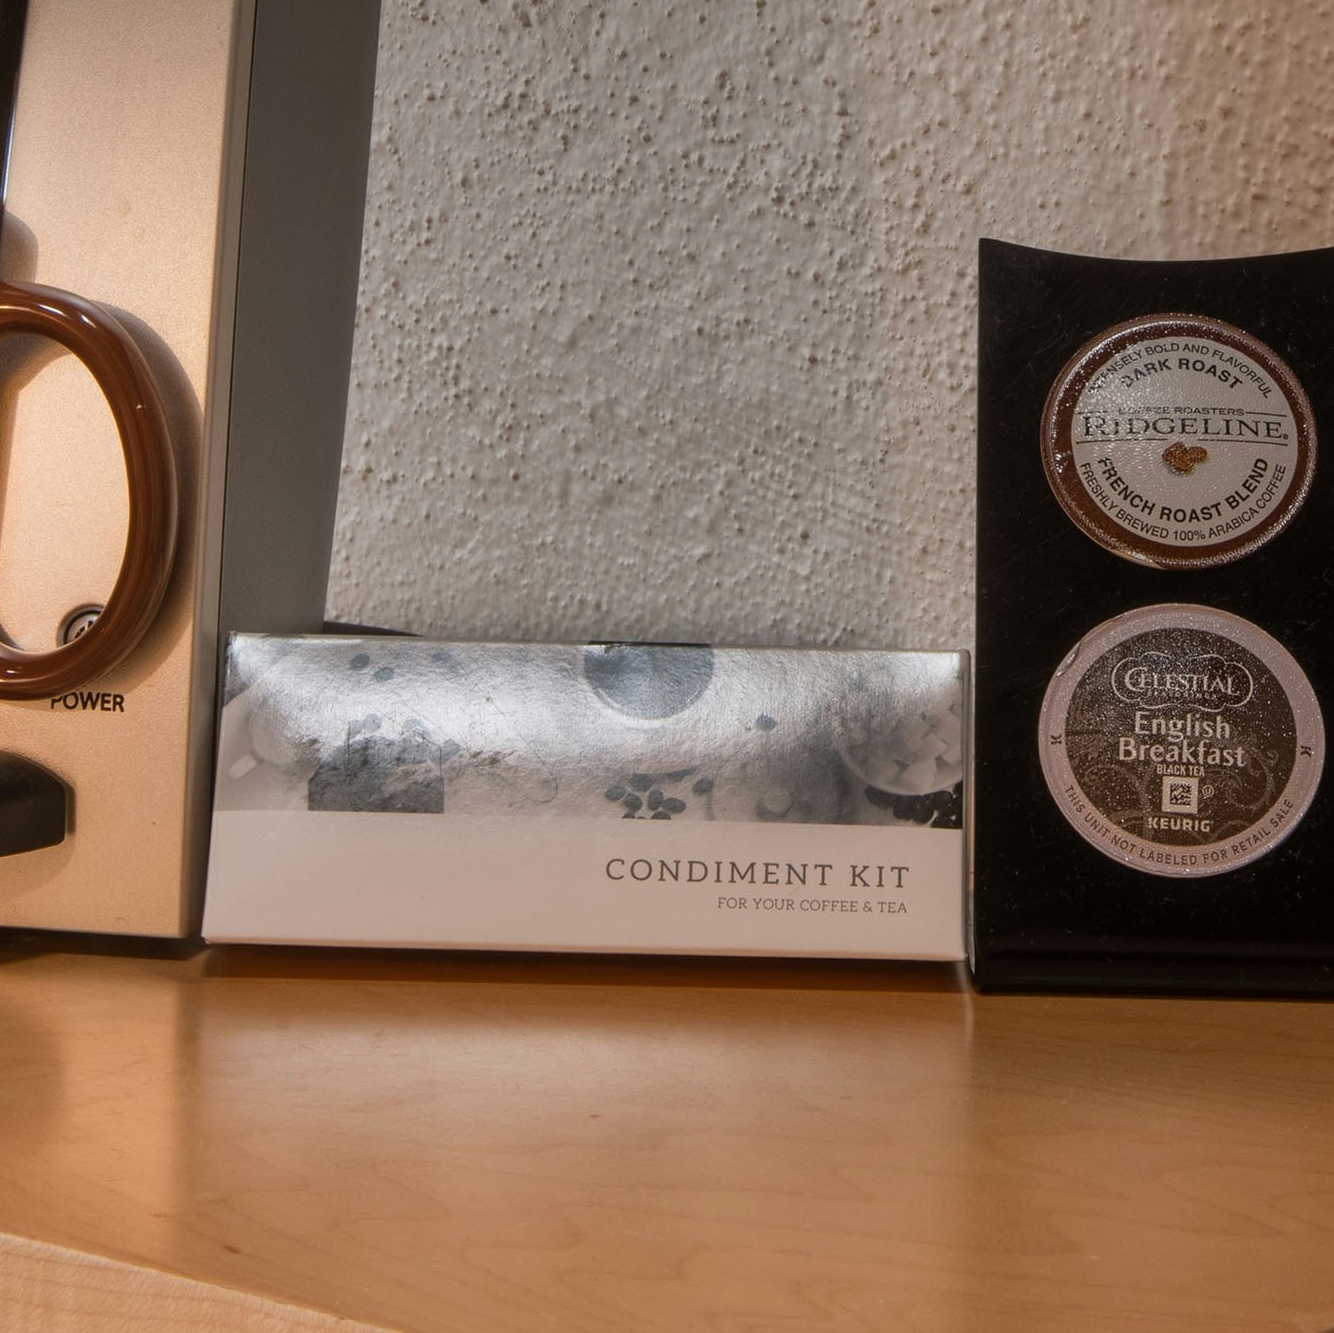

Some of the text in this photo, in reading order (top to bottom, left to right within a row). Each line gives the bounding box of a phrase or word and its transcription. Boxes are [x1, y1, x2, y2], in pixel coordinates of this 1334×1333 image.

[1120, 357, 1244, 390] DARK ROAST
[1145, 342, 1180, 356] BOLD
[1182, 342, 1209, 355] AND
[1212, 349, 1273, 399] FLAVORFUL
[1173, 406, 1246, 416] ROASTERS
[1080, 461, 1287, 542] FRESHLY BREWED 100% ARABICA COFFEE
[1097, 457, 1269, 524] FRENCH ROAST BLEND
[1124, 666, 1240, 696] CELESTIAL
[1134, 711, 1231, 743] English
[1118, 738, 1246, 768] Breakfast
[1157, 764, 1206, 777] BLACK TEA
[1065, 785, 1294, 866] THIS UNIT NOT LABELED FOR RETAIL SALE
[1147, 817, 1211, 833] KEURIG
[605, 858, 910, 888] CONDIMENT KIT
[717, 896, 908, 914] FOR YOUR COFFEE & TEA
